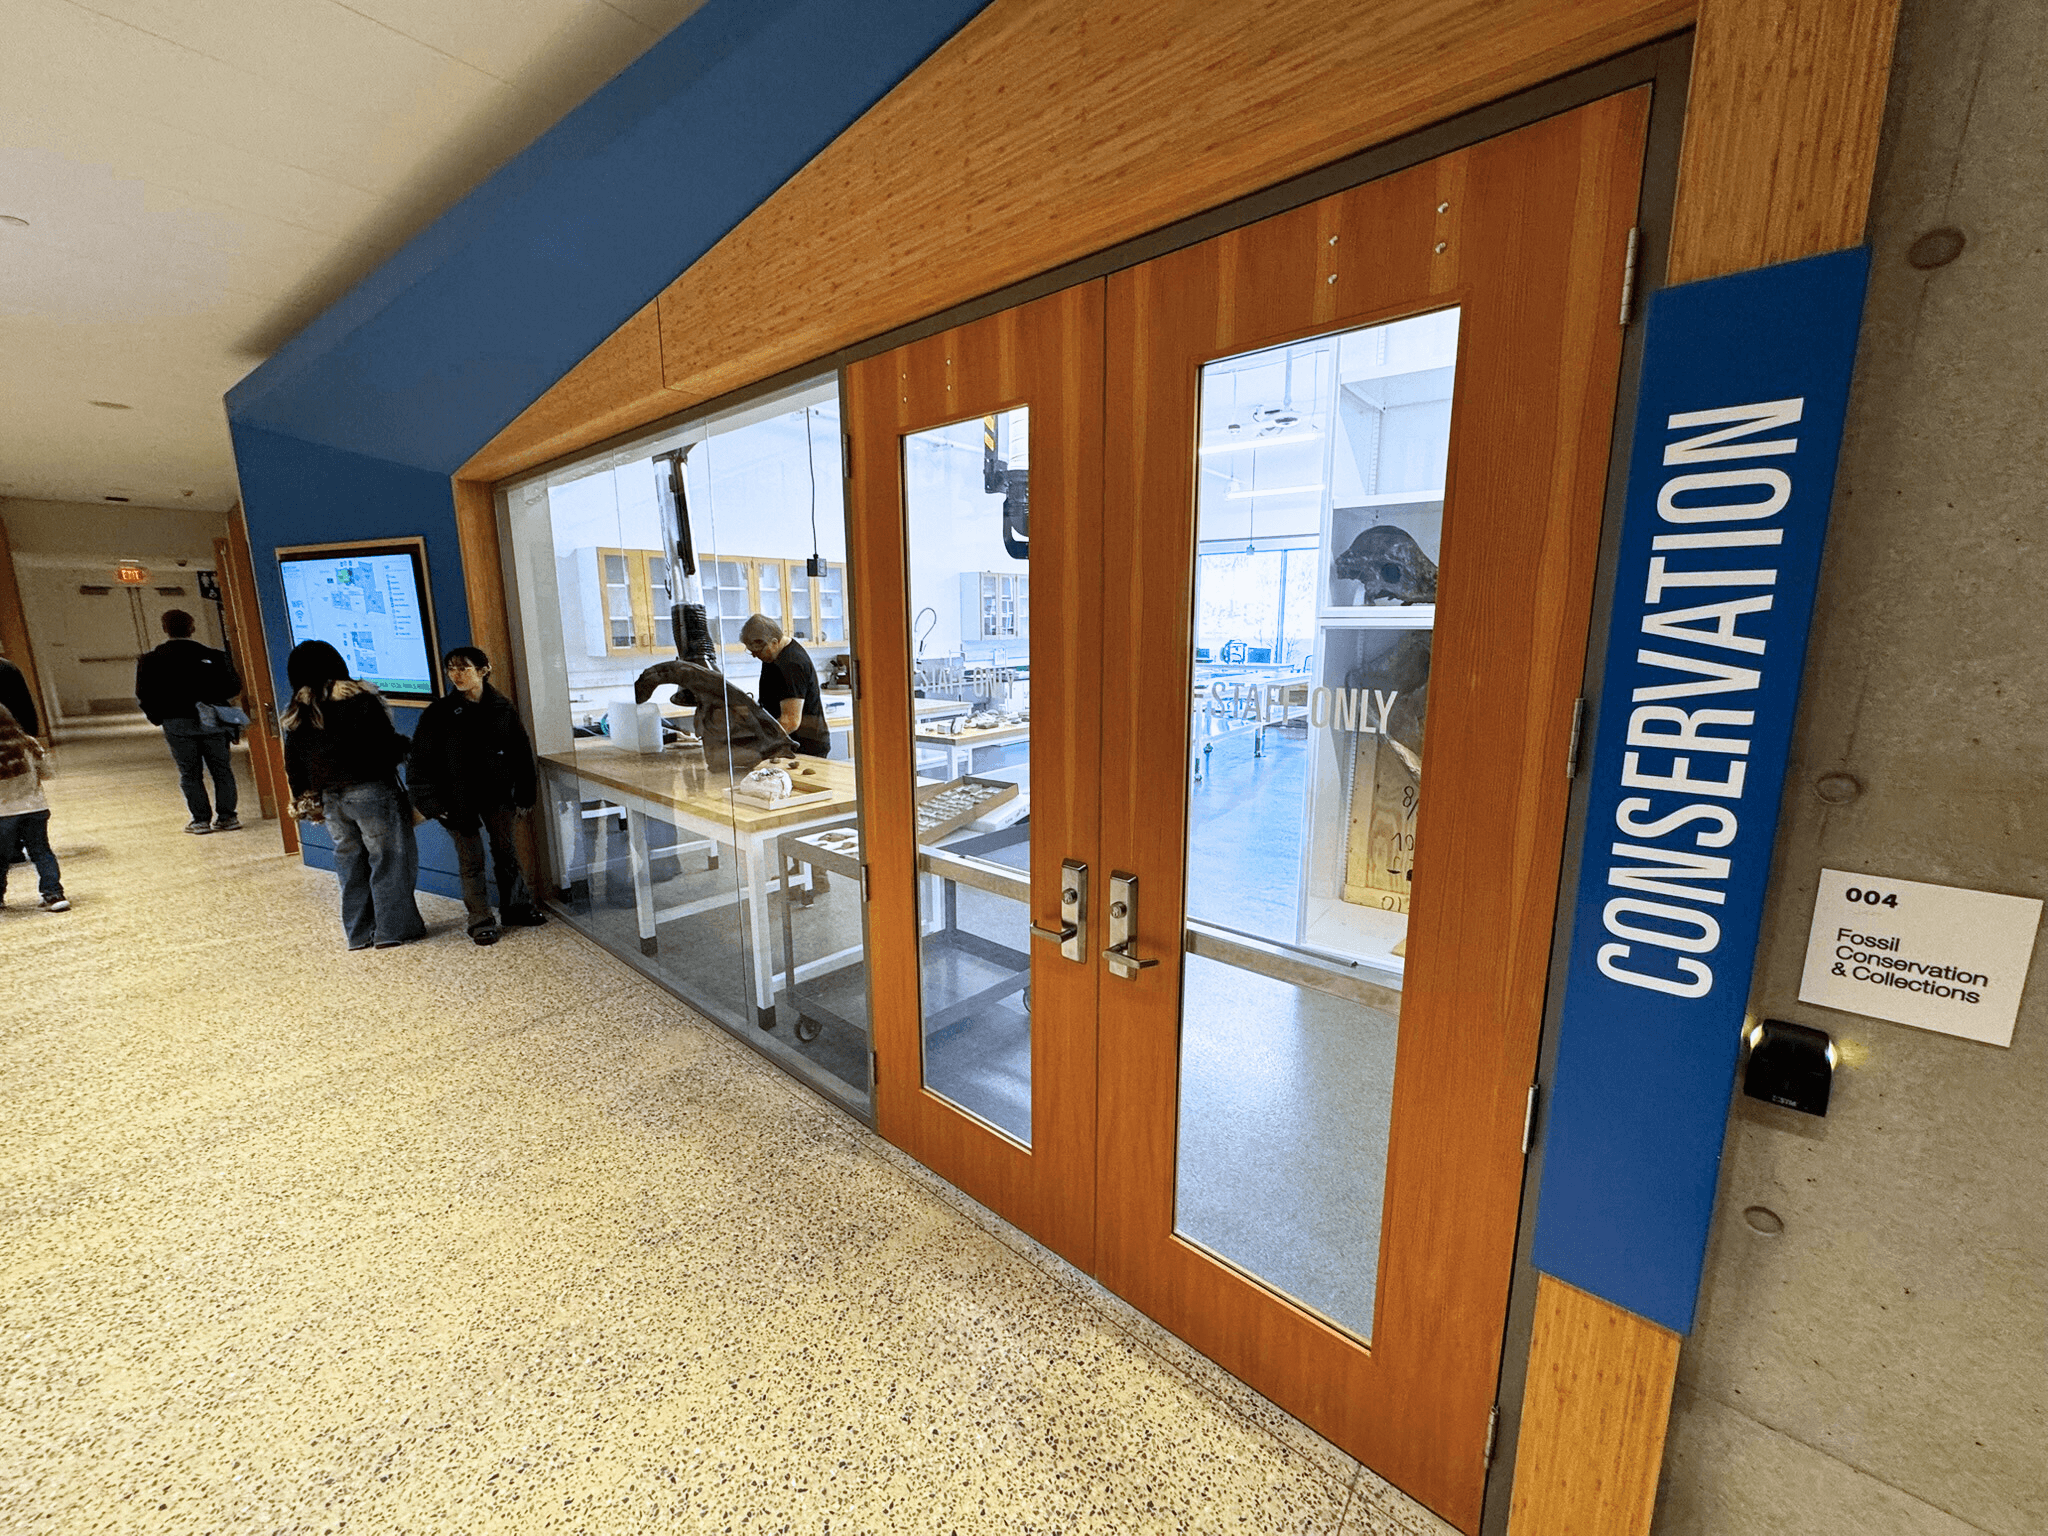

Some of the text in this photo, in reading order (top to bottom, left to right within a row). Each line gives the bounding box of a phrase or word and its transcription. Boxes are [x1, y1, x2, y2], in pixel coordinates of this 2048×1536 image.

[121, 569, 139, 580] EXIT
[973, 666, 1016, 700] ONLY
[1595, 396, 1804, 1000] CONSERVATION
[1210, 681, 1398, 735] STAFF ONLY
[1845, 887, 1899, 909] 004
[1836, 927, 1901, 952] Fossil
[1831, 961, 1981, 1004] & Collections
[1835, 945, 1989, 987] Conservation
